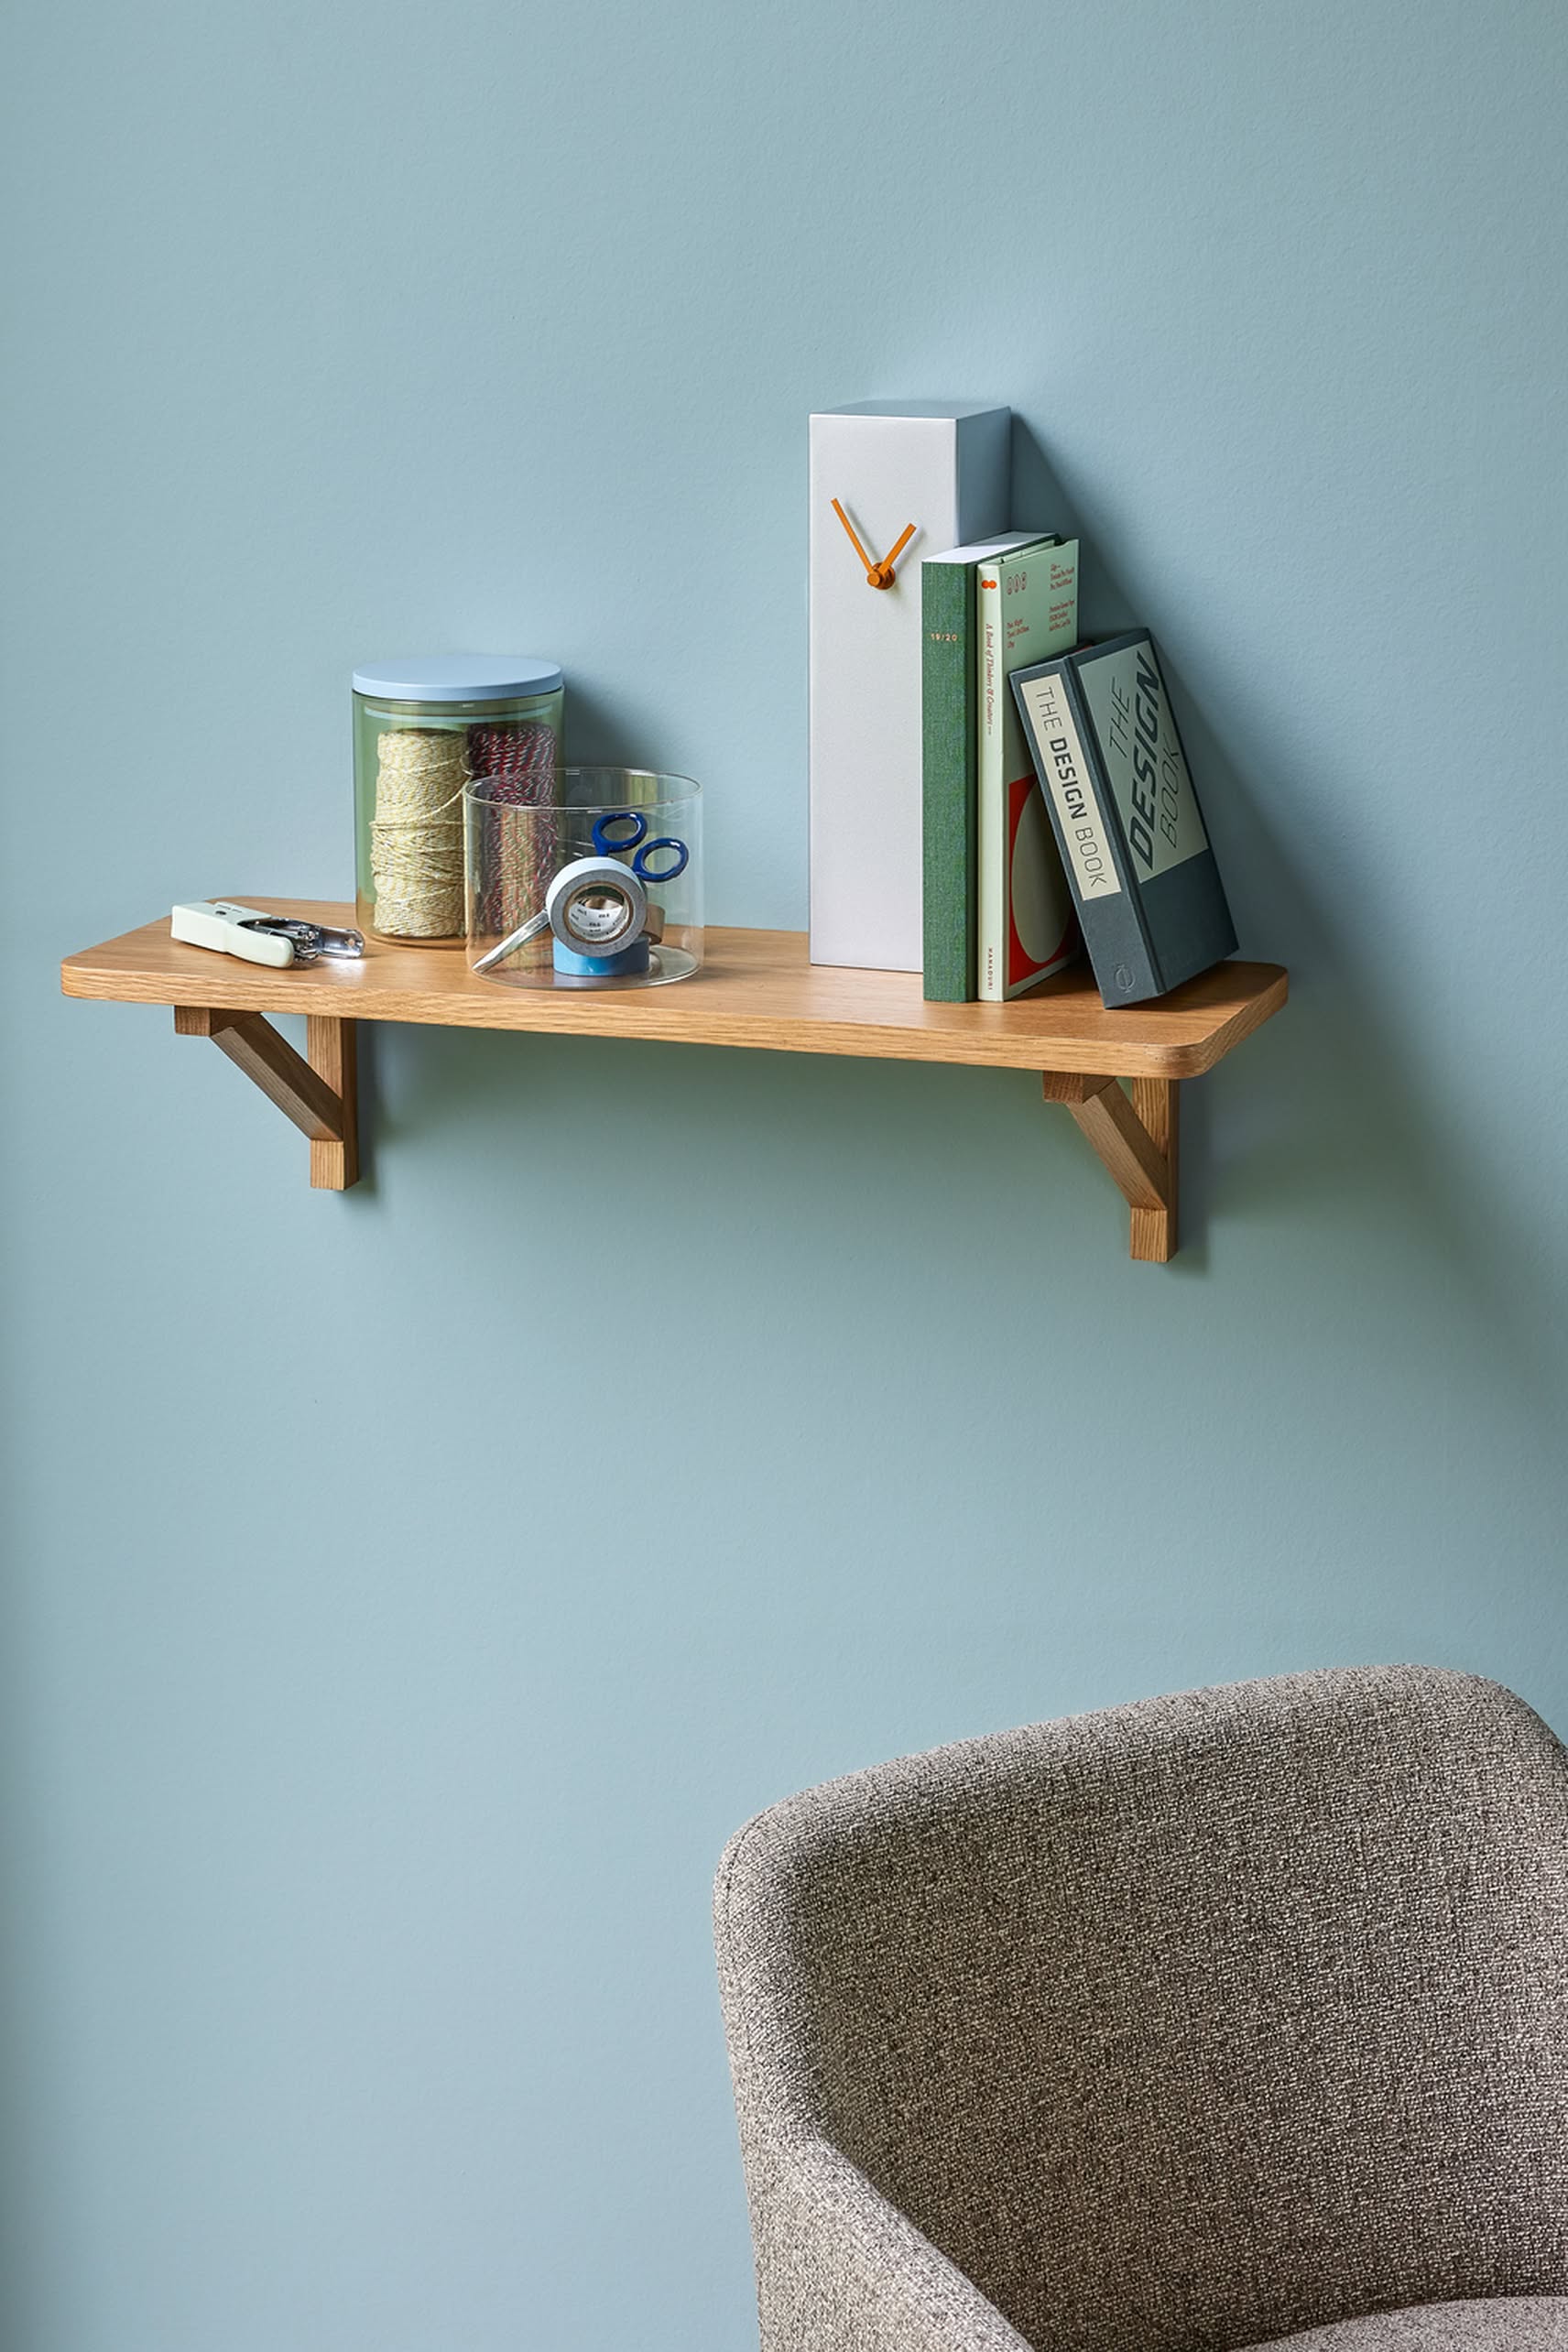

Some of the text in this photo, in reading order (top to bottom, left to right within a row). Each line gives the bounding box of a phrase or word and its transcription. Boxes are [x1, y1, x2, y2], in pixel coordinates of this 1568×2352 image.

[985, 631, 994, 648] Book
[985, 649, 994, 658] of
[1109, 677, 1130, 758] THE
[1129, 650, 1160, 871] DESIGN
[1036, 687, 1107, 887] THE DESIGN BOOK
[1160, 732, 1180, 849] BOOK
